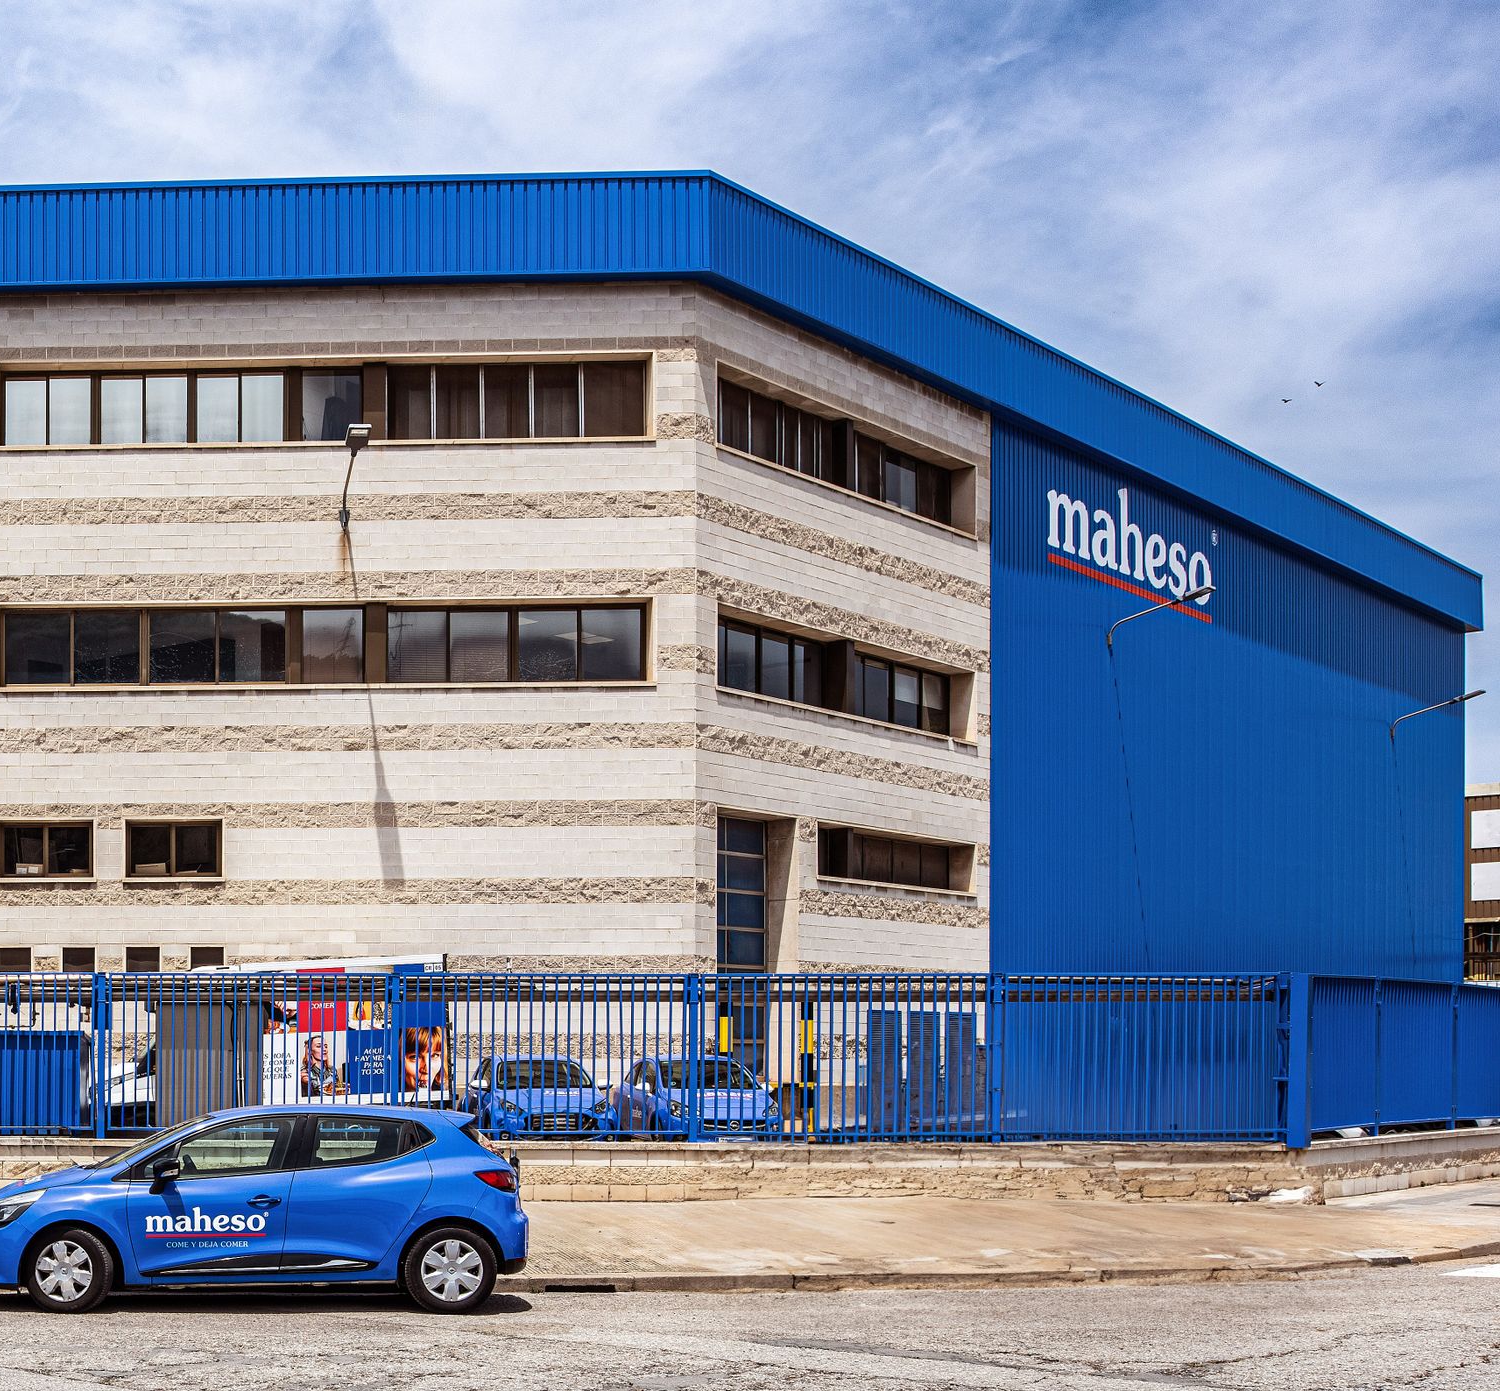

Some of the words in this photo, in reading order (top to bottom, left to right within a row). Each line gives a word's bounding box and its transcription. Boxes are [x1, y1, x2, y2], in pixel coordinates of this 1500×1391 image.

[1047, 488, 1212, 606] maheso
[145, 1207, 266, 1232] maheso
[166, 1241, 189, 1249] COME
[198, 1241, 219, 1249] DEJA
[220, 1240, 249, 1249] COMER
